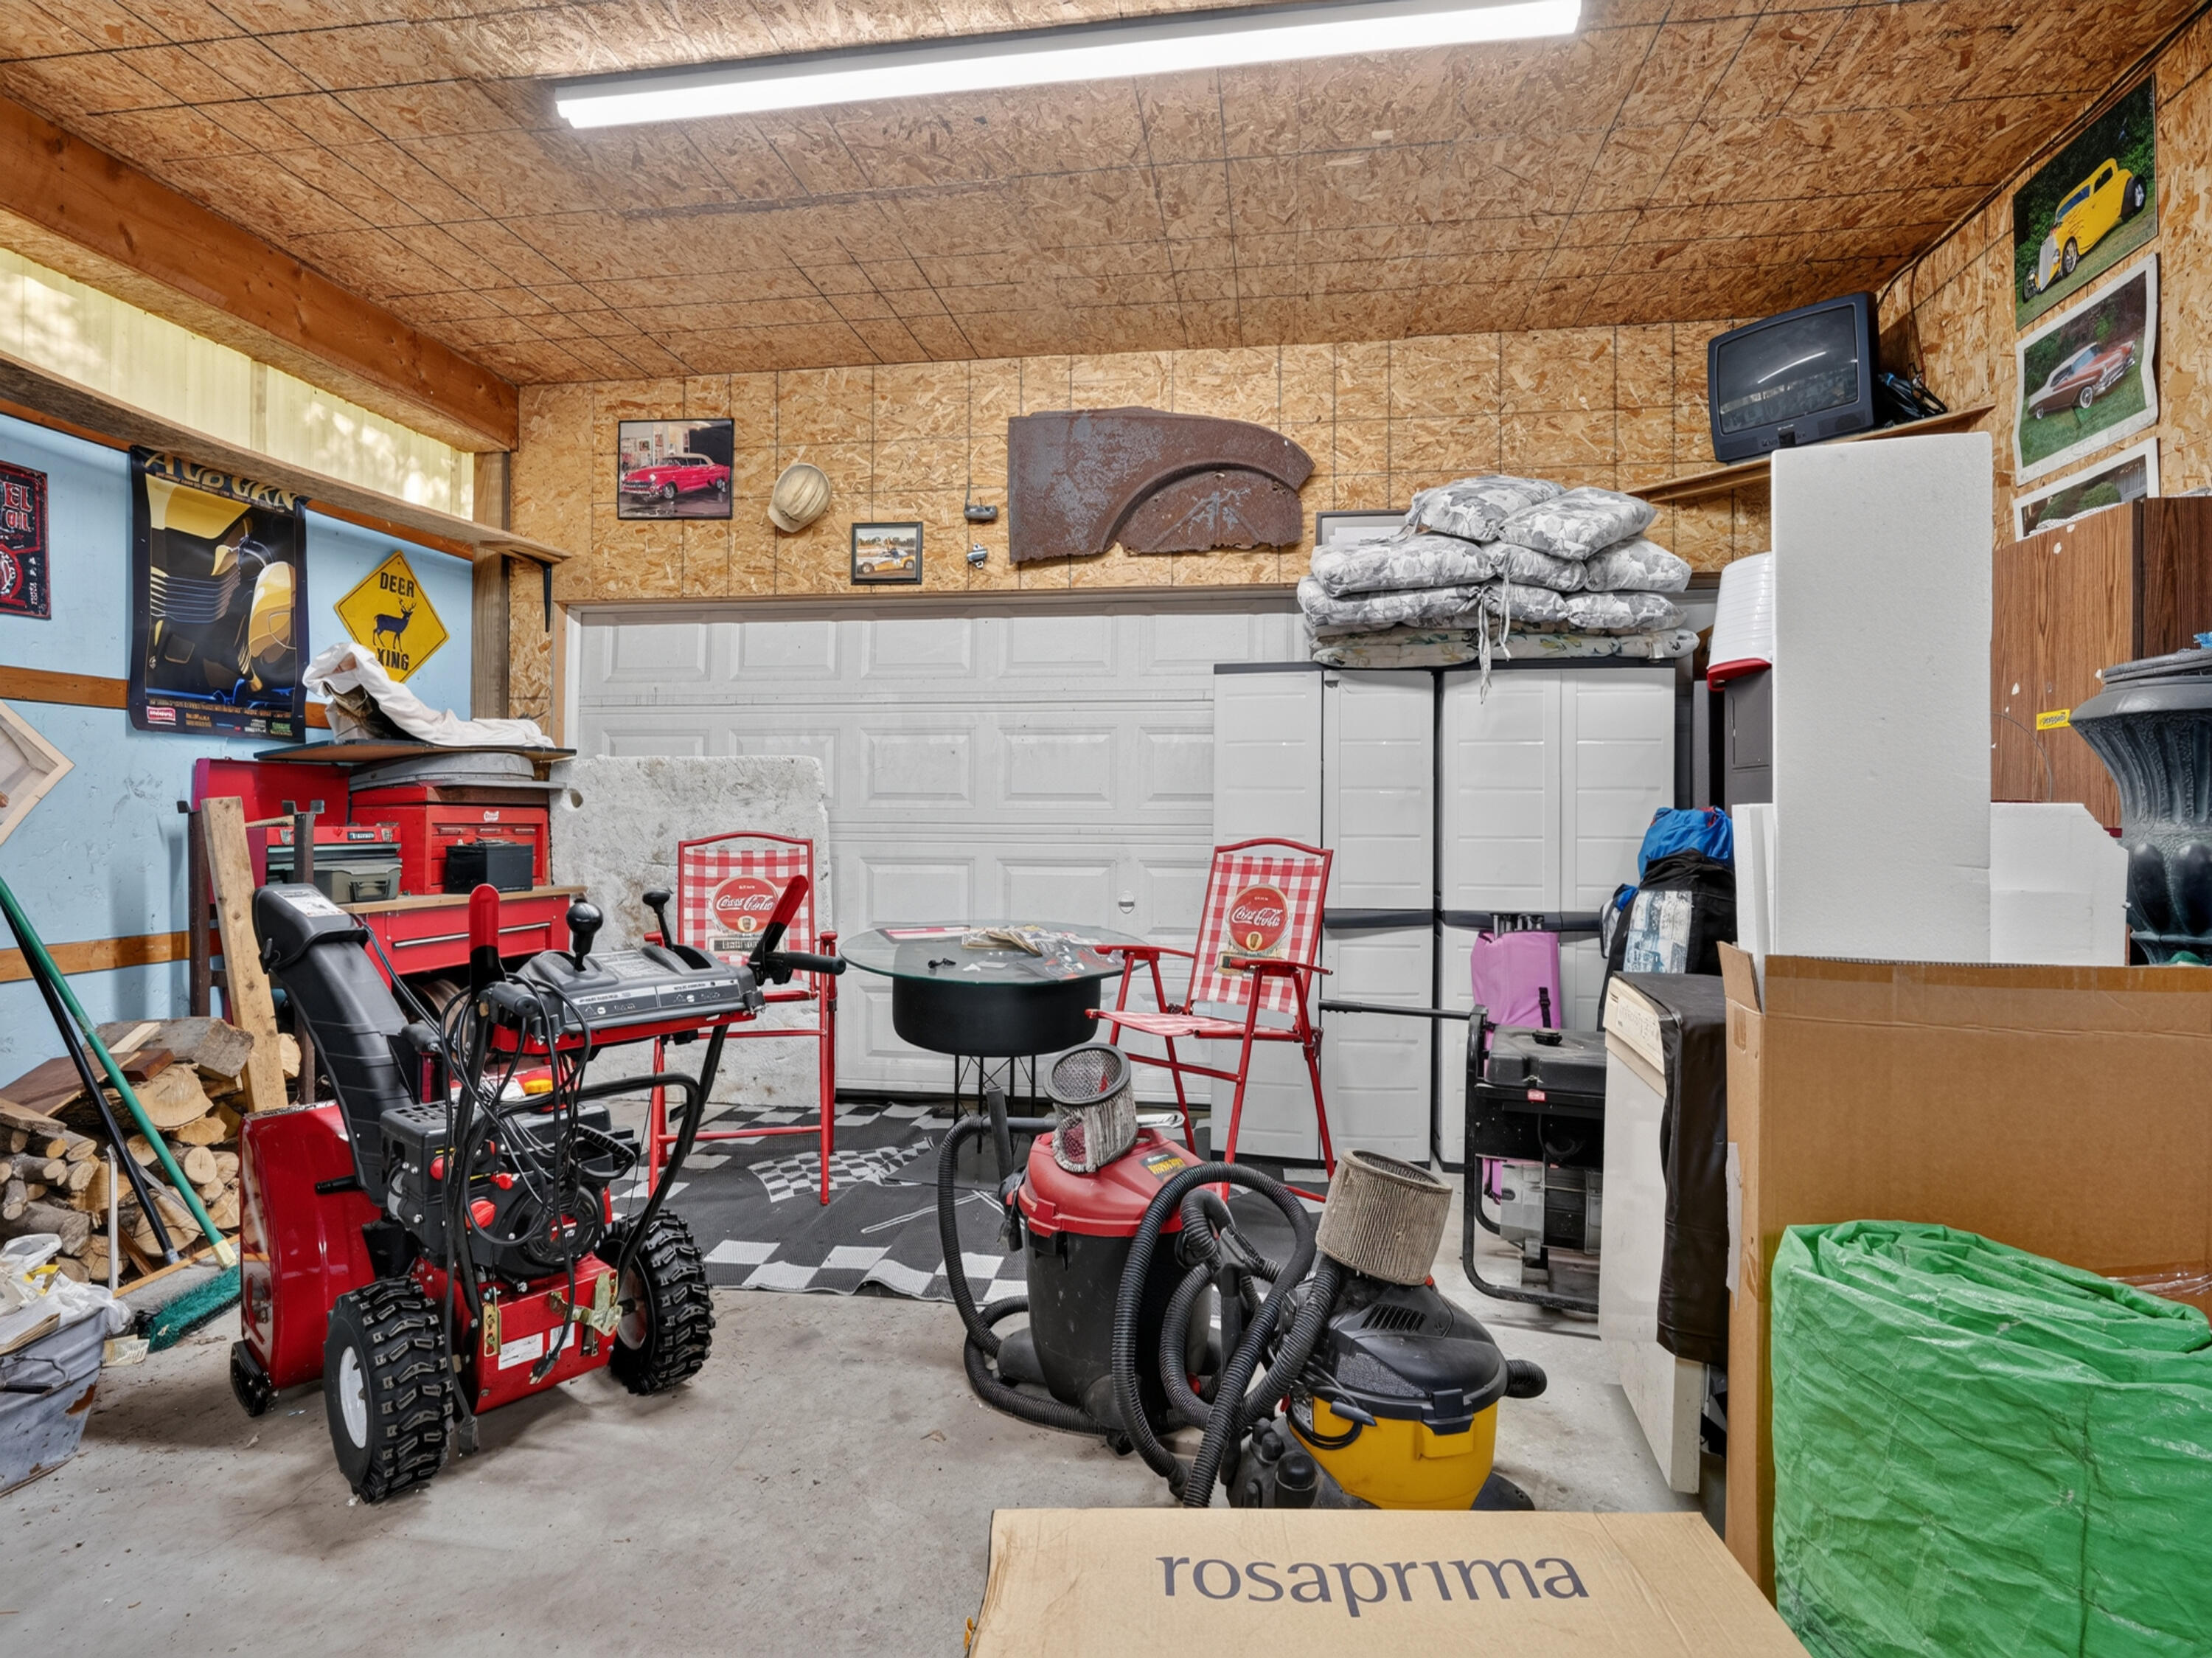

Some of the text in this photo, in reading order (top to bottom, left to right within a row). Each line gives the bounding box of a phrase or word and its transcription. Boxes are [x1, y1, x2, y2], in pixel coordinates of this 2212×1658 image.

[380, 572, 415, 598] DEER
[377, 648, 410, 670] XING
[1155, 1557, 1590, 1617] rosaprima
